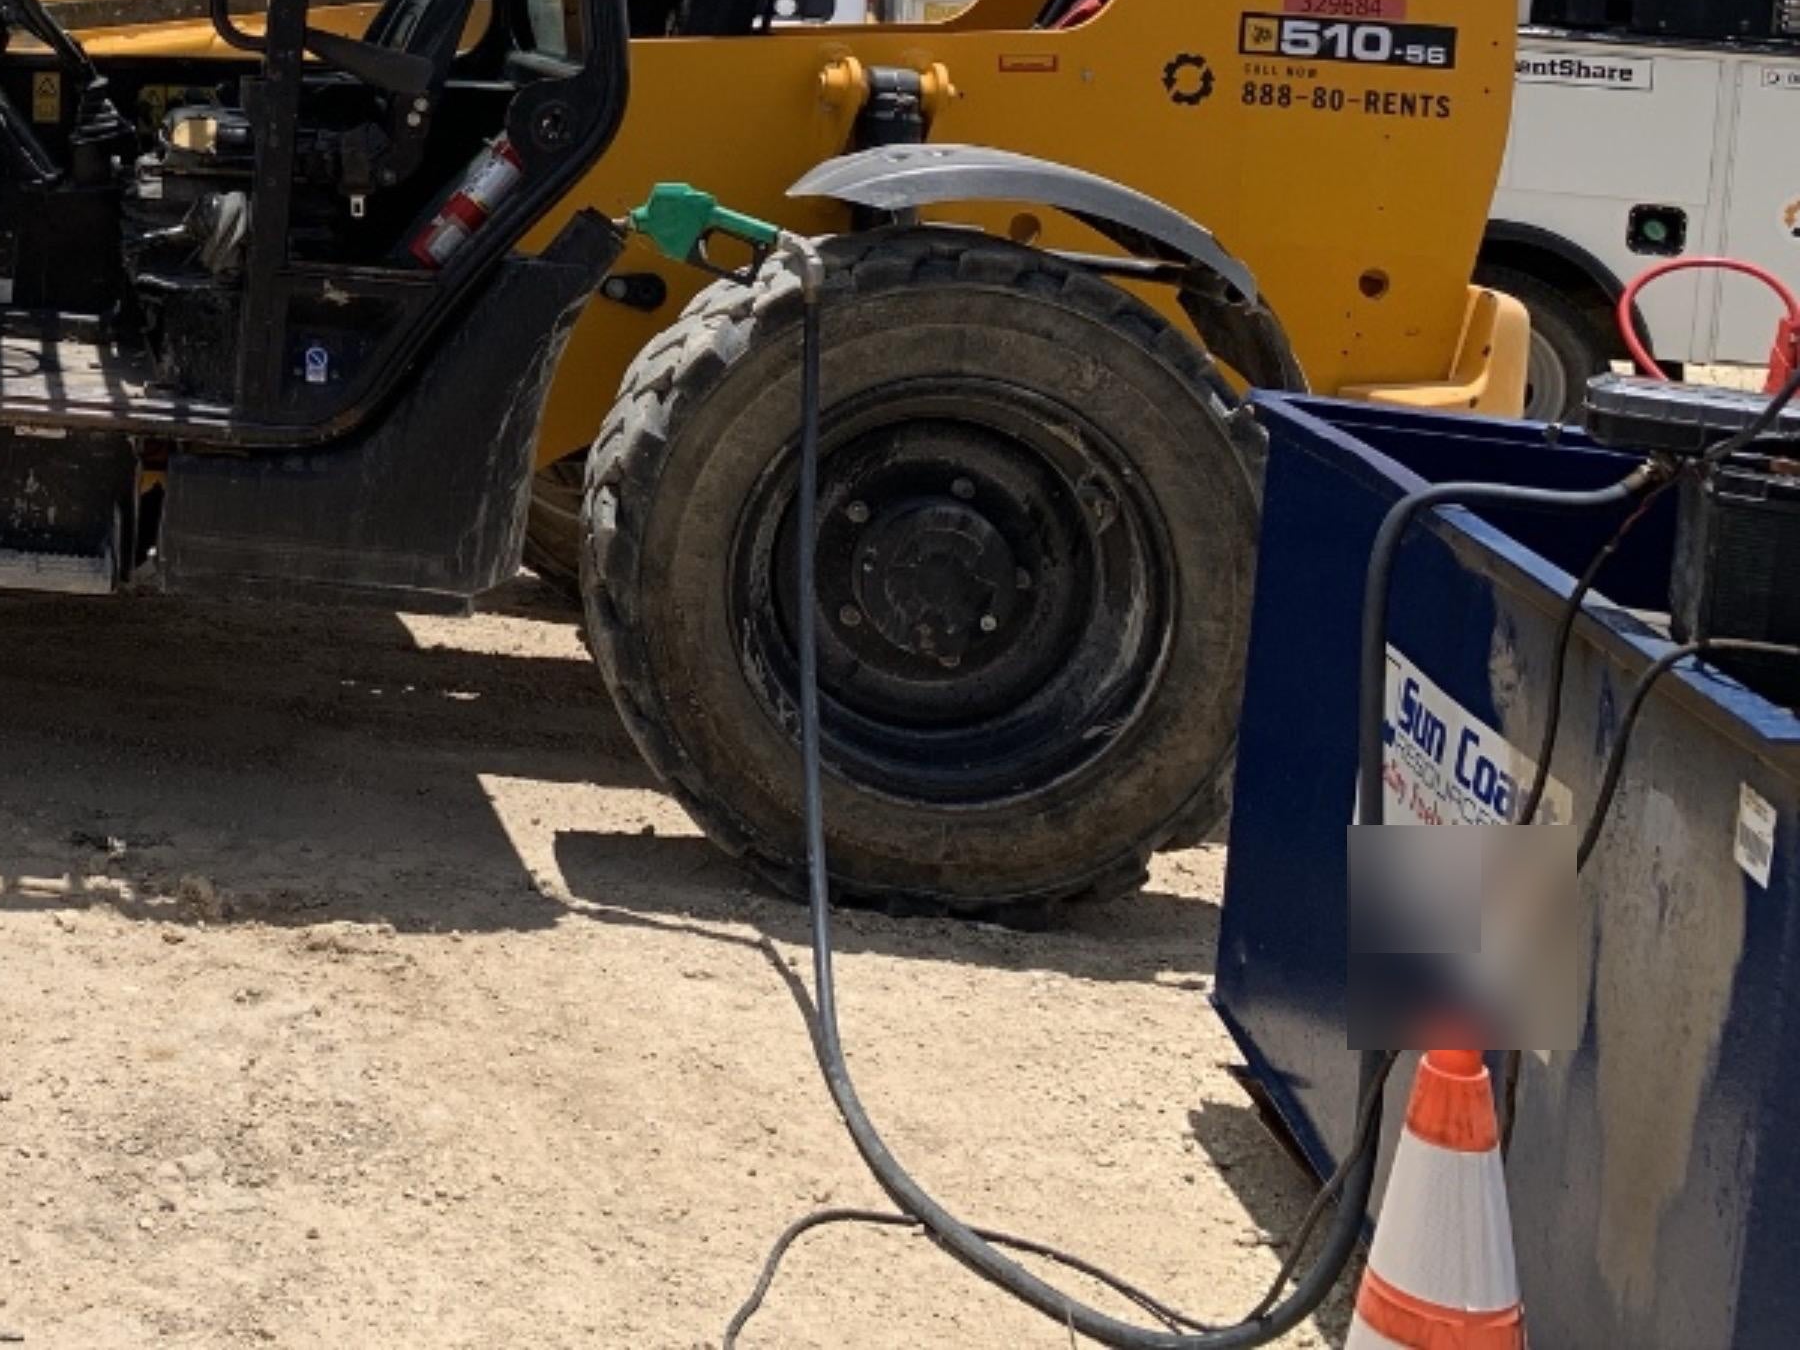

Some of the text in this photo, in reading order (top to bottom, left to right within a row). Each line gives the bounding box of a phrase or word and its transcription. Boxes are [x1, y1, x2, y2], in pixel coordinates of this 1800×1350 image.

[1280, 19, 1447, 65] 510-56
[1244, 62, 1319, 79] CALL NOW
[1515, 58, 1634, 82] entShare
[1241, 81, 1451, 119] 888-80-RENTS
[1398, 677, 1447, 766] Sun
